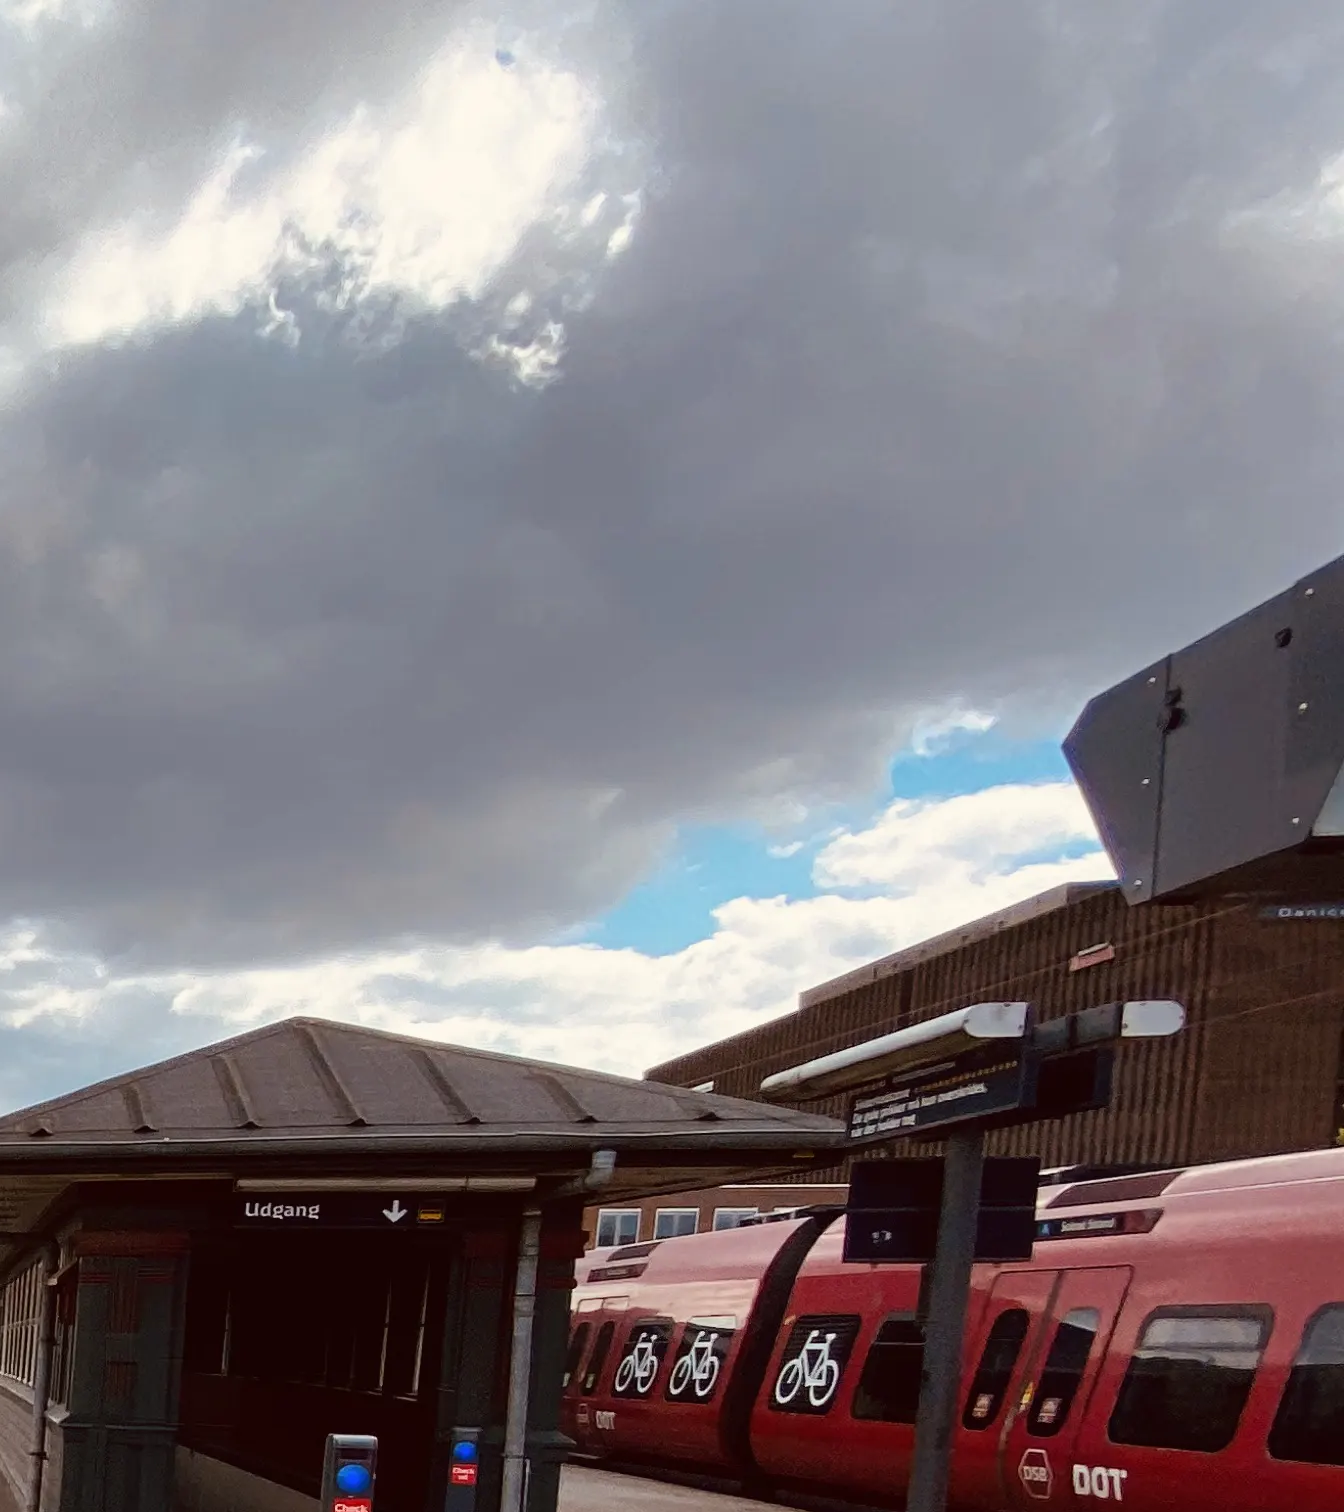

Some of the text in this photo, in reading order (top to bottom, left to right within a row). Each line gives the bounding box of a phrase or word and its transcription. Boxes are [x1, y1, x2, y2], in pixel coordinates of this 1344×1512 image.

[245, 1203, 320, 1220] Udgang
[453, 1466, 474, 1475] Check
[1073, 1464, 1127, 1501] DOT
[334, 1503, 368, 1512] Check
